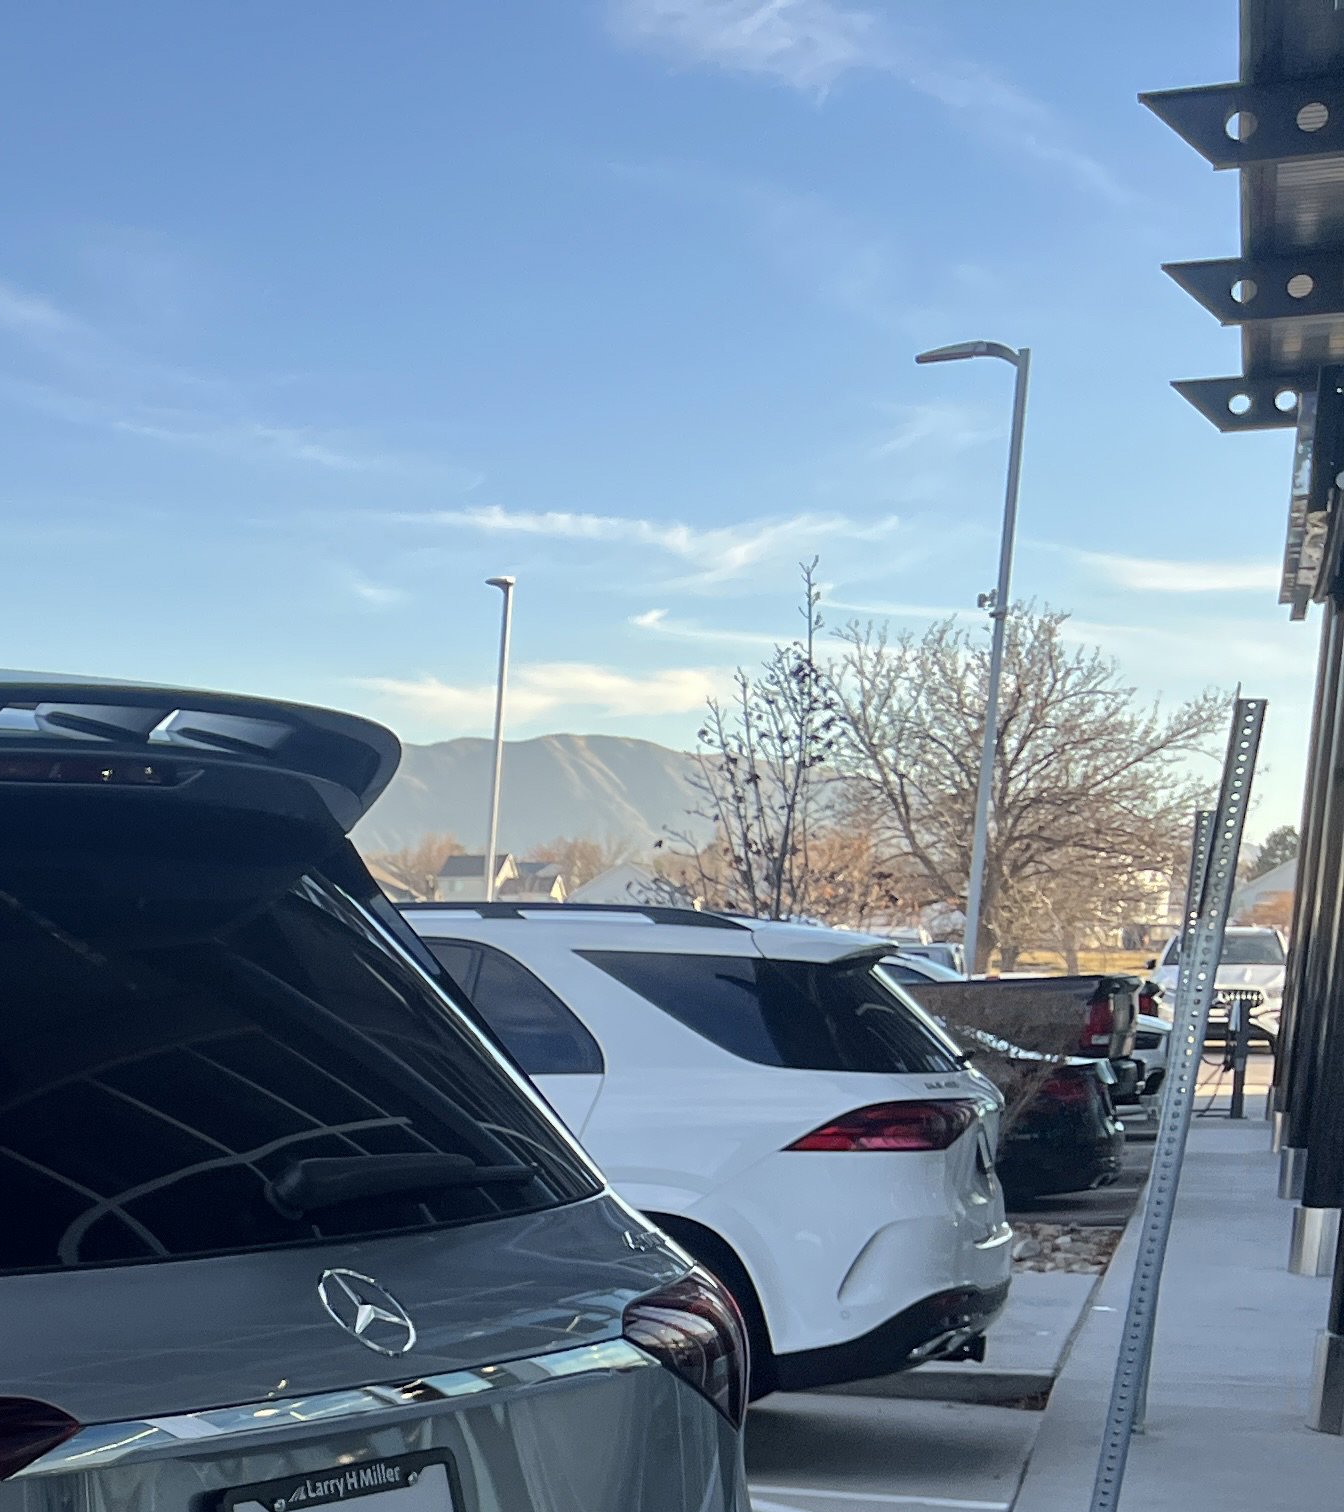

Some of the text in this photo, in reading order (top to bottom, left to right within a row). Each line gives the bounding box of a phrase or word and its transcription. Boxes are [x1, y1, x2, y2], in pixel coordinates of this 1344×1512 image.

[305, 1463, 400, 1498] Larry H Miller
